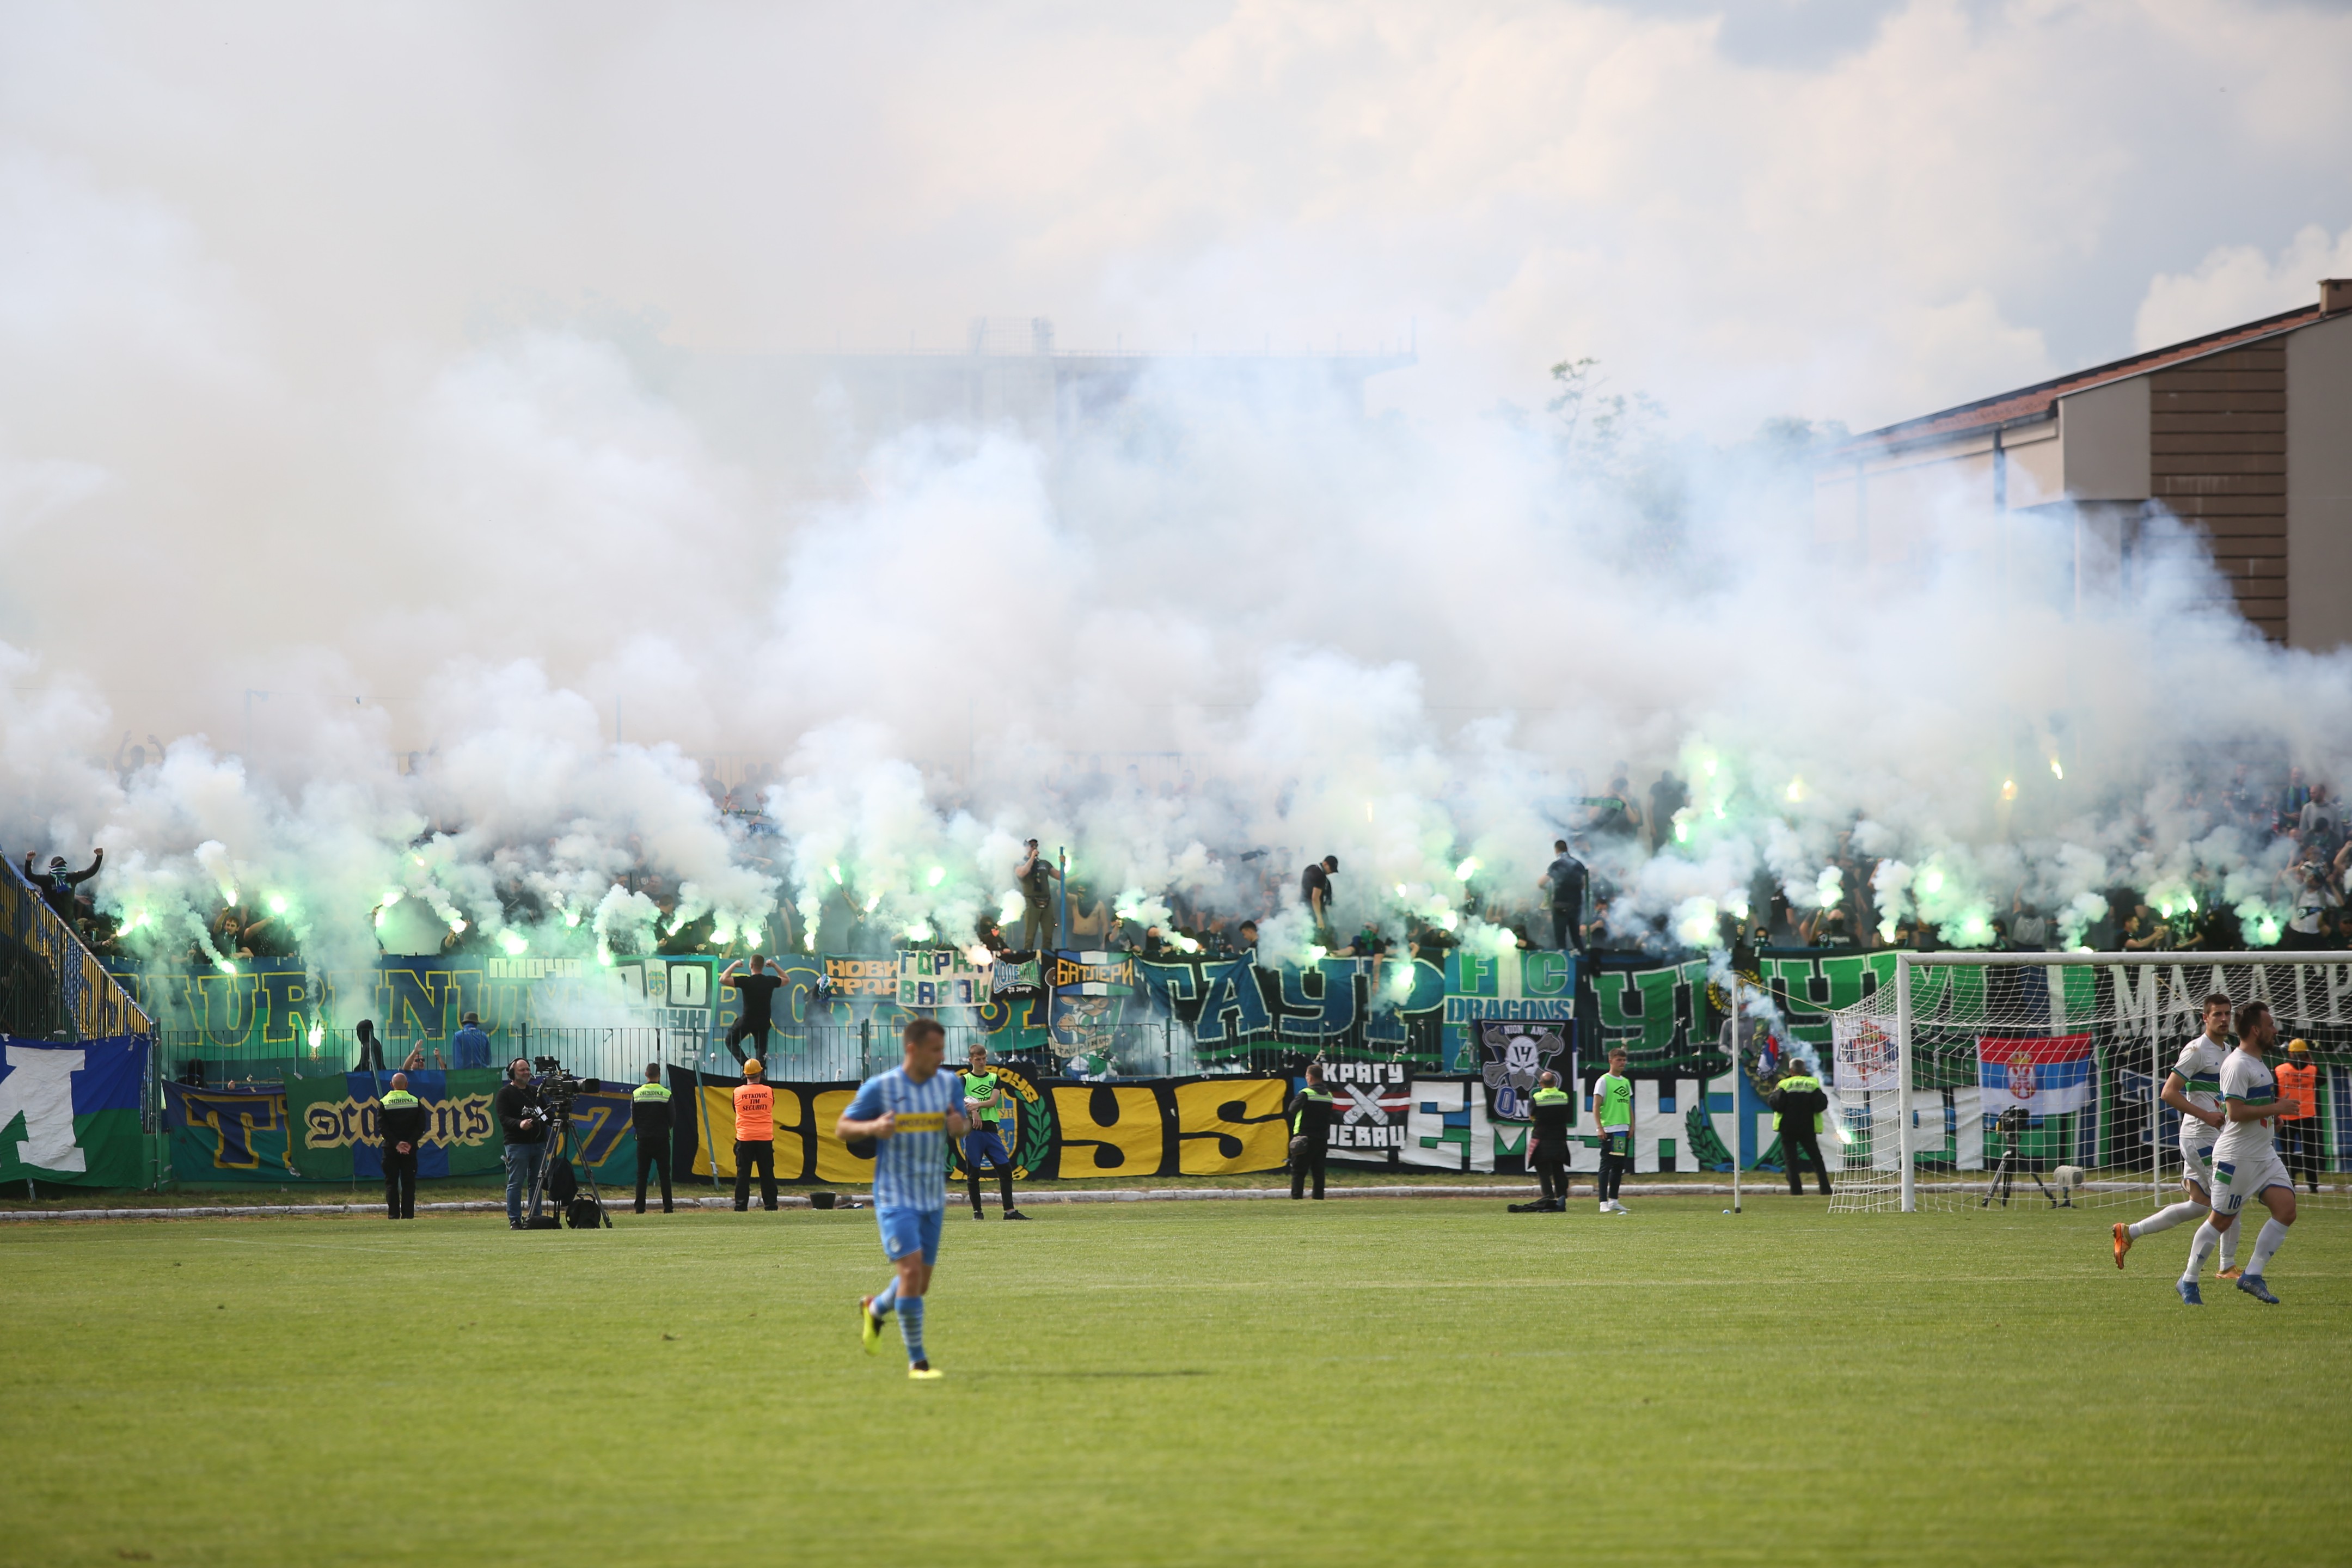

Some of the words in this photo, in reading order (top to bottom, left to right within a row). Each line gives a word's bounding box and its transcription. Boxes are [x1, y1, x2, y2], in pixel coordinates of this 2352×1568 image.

[1057, 958, 1133, 987] БАТЛЕРИ
[1446, 998, 1571, 1020] DRAGONS
[1322, 1063, 1404, 1083] КРАГУ
[2228, 1194, 2242, 1210] 10
